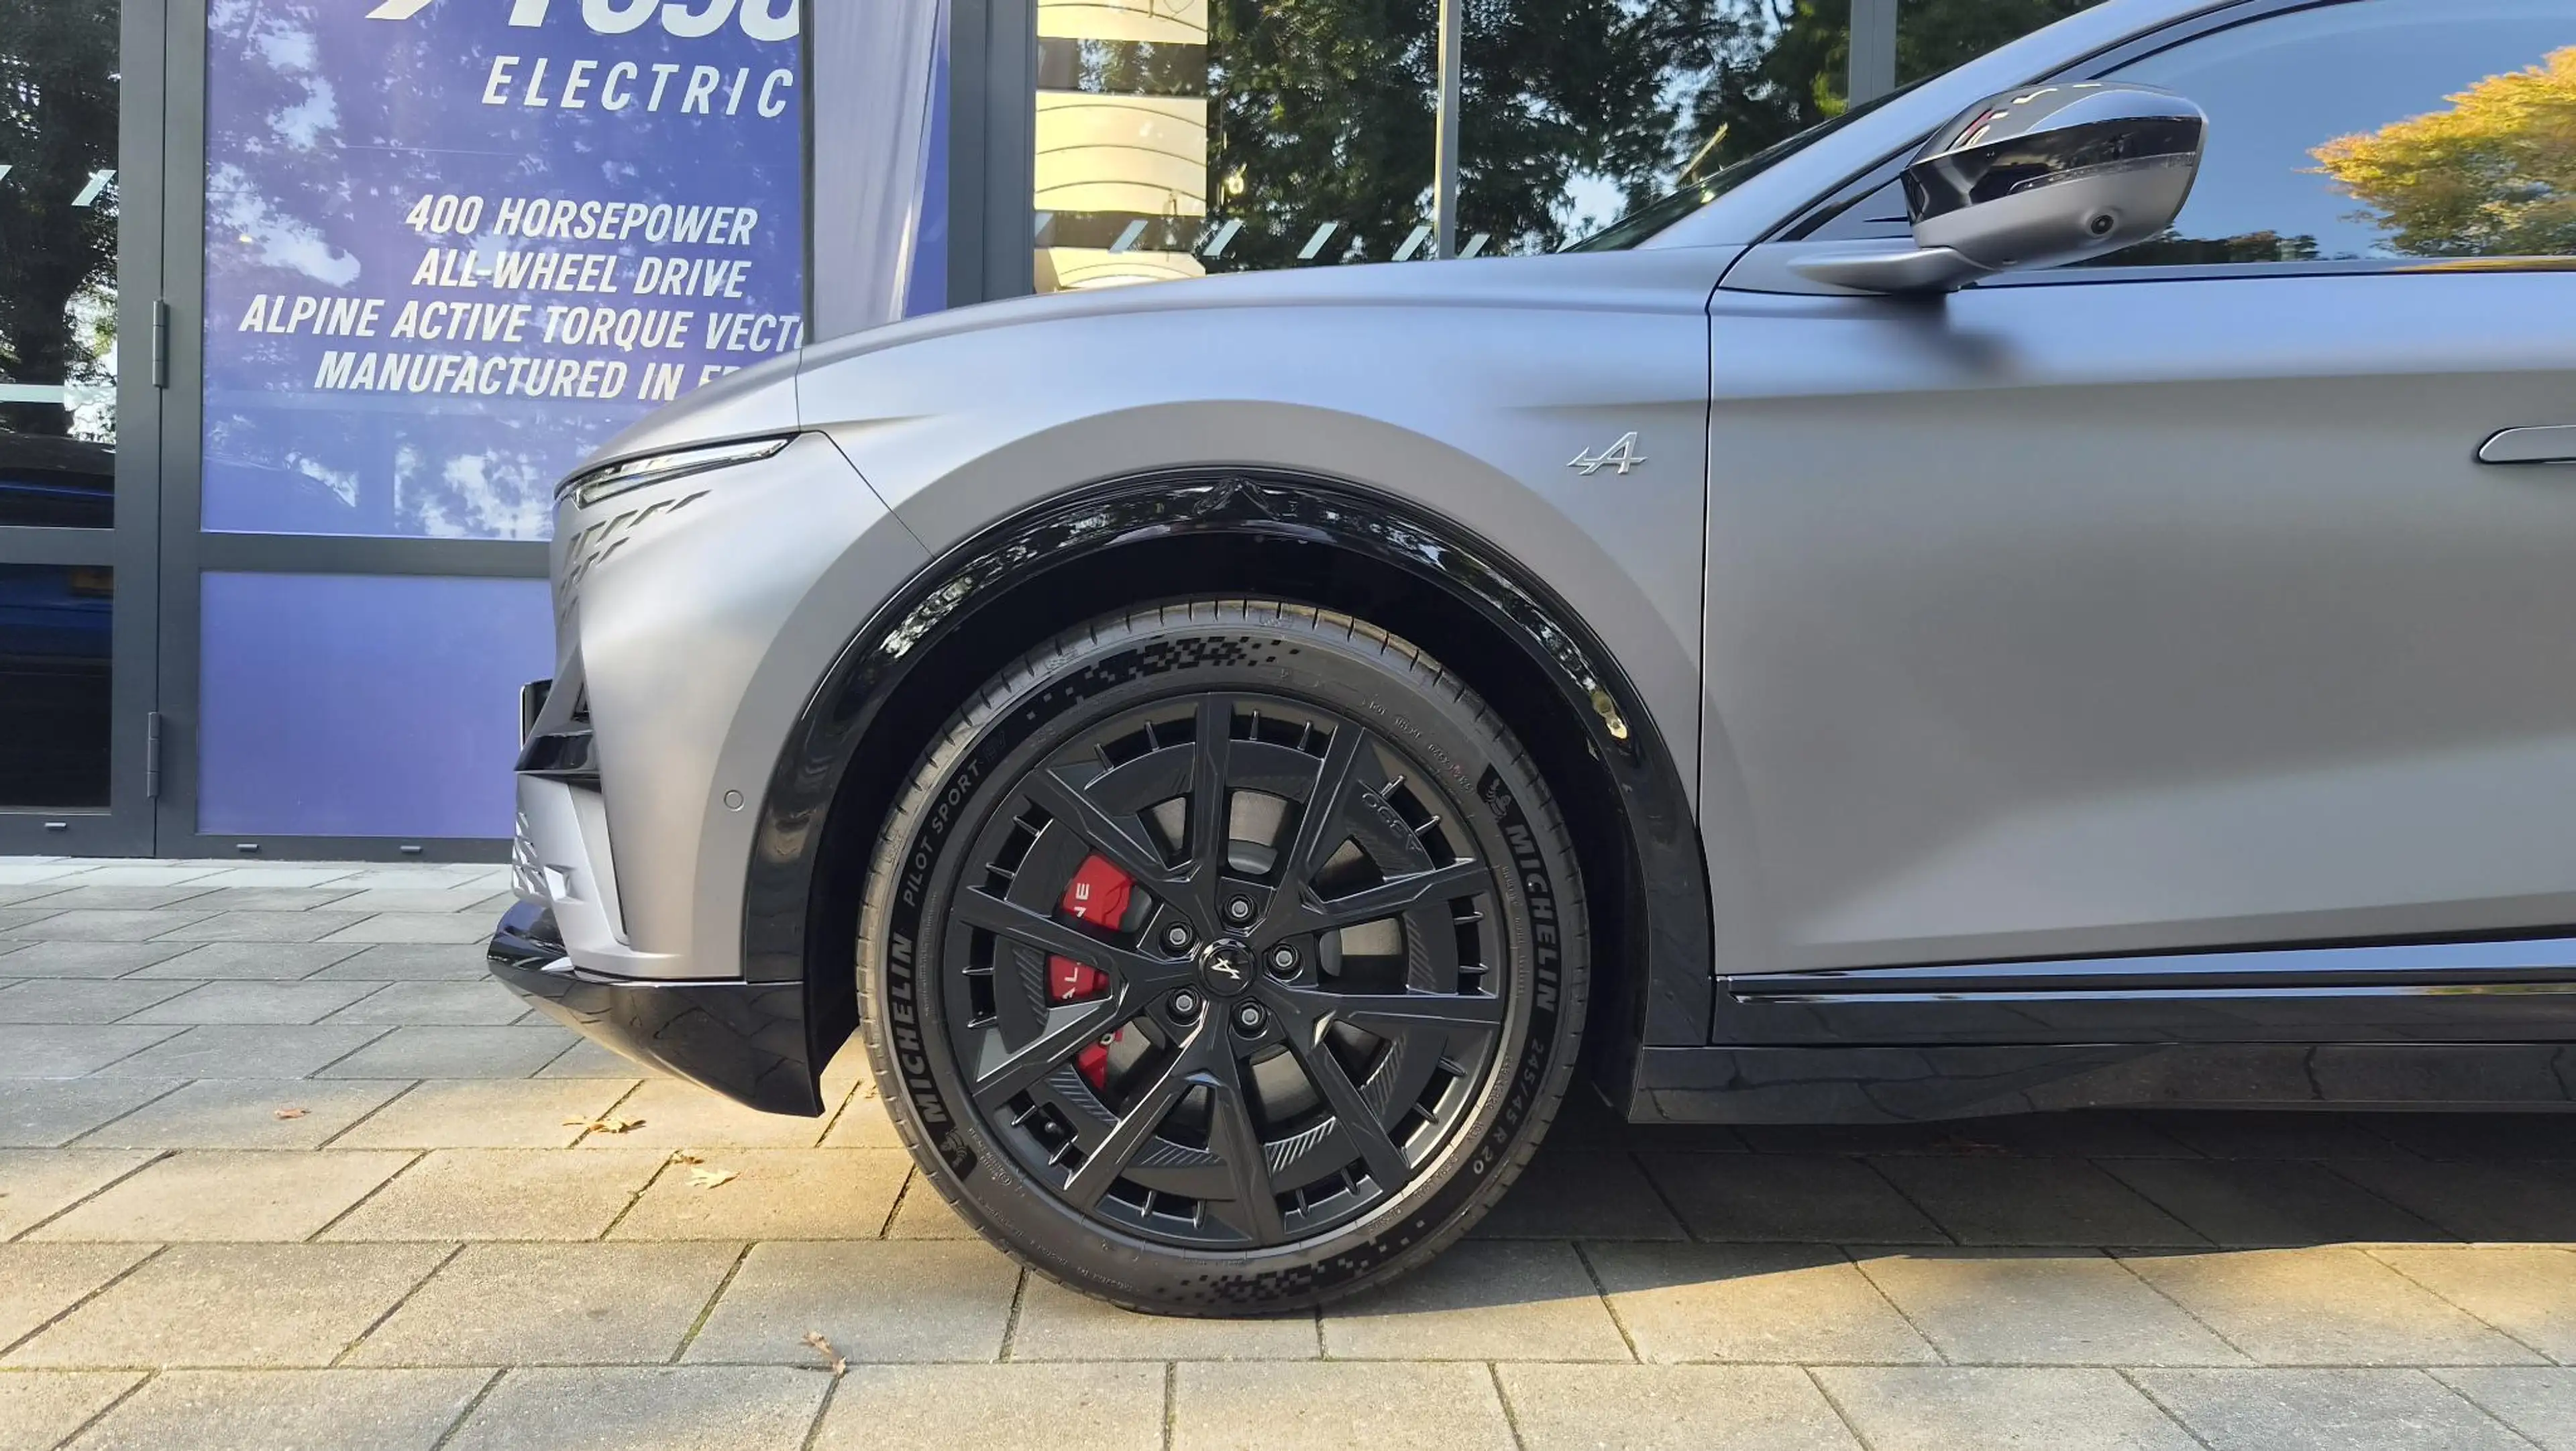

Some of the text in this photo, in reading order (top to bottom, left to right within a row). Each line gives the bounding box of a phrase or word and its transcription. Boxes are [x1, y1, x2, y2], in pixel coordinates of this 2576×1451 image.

[482, 56, 794, 118] ELECTRIC
[405, 195, 758, 245] 400 HORSEPOWER
[411, 248, 752, 298] ALL-WHEEL DRIVE
[238, 294, 385, 337] ALPINE
[390, 300, 532, 342] ACTIVE
[543, 305, 694, 352] TORQUE
[314, 350, 627, 398] MANUFACTURED
[637, 362, 685, 401] IN
[904, 836, 932, 906] PILOT
[932, 759, 979, 834] SPORT
[1505, 824, 1558, 1012] MICHELIN
[891, 932, 947, 1124] MICHELIN
[1473, 1038, 1544, 1174] 245/45 R 20
